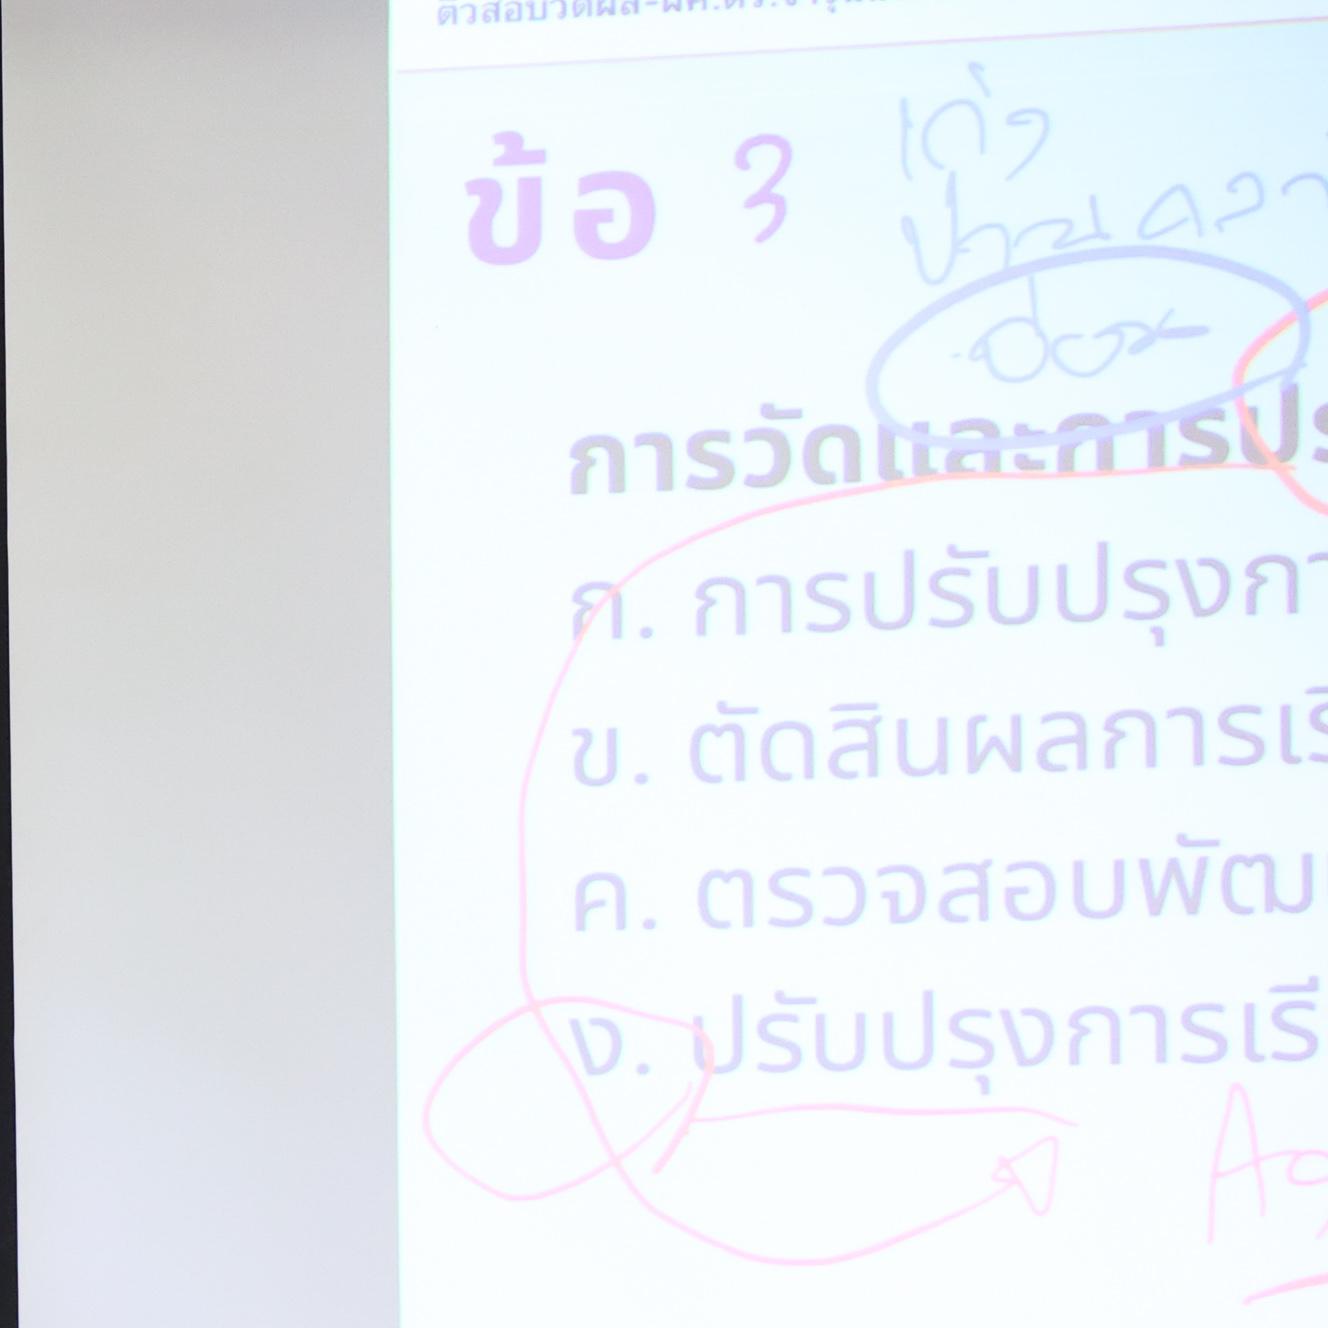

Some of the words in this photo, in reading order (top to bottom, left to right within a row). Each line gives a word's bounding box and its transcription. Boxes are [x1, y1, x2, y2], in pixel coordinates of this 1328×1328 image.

[464, 130, 657, 266] ข้อ
[734, 133, 793, 244] 3
[571, 577, 654, 641] ก.
[570, 725, 649, 787] ข.
[574, 869, 658, 934] ค.
[696, 832, 1328, 930] ตรวจสอบพัฒ
[568, 1016, 652, 1077] ง.
